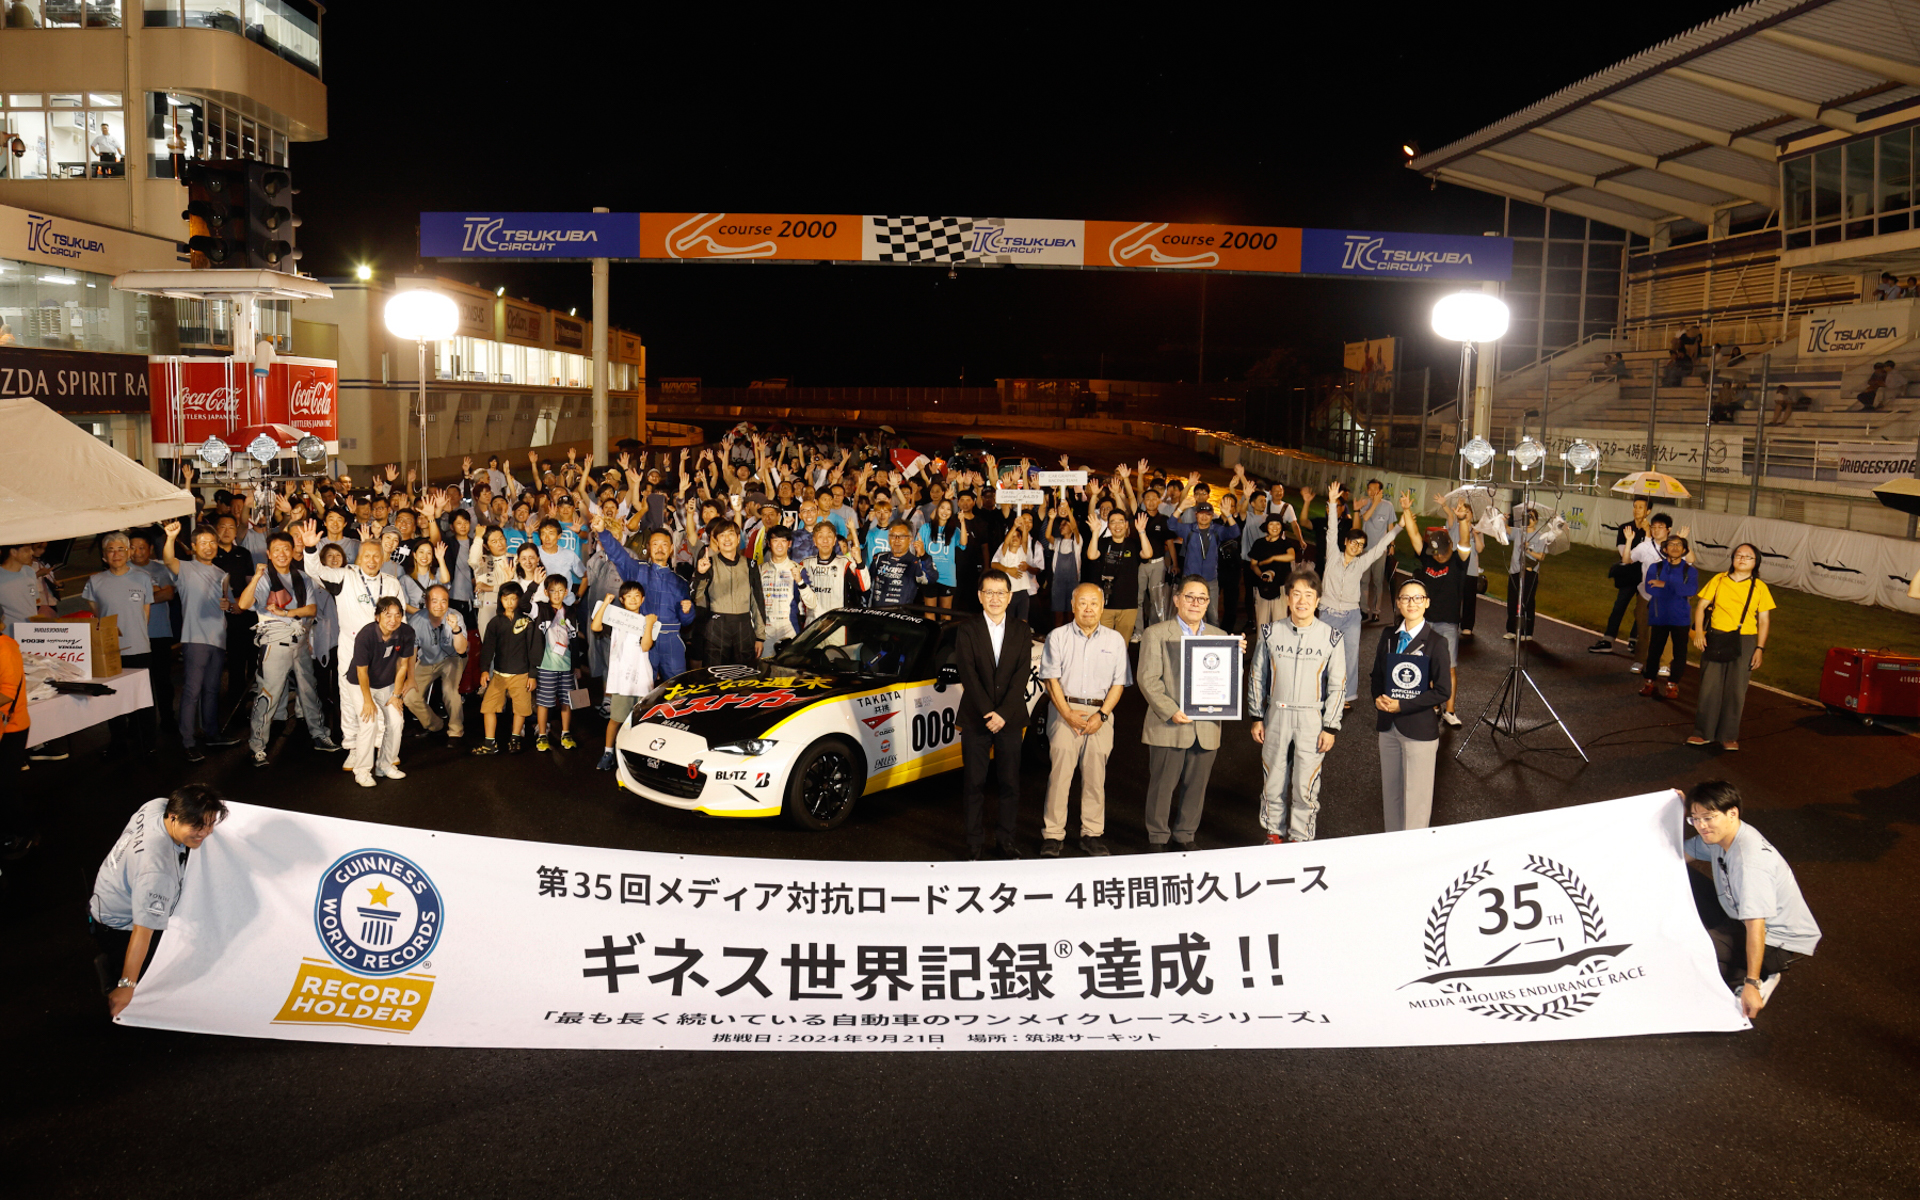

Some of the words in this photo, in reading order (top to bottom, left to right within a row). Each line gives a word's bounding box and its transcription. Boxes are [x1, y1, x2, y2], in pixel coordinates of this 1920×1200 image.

[502, 229, 598, 242] TSUKUBA
[718, 224, 773, 236] course
[777, 220, 838, 239] 2000
[52, 233, 105, 254] TSUKUBA
[1000, 237, 1077, 248] TSUKUBA
[1162, 232, 1215, 246] course
[1219, 231, 1279, 251] 2000
[1382, 249, 1473, 265] TSUKUBA
[1834, 327, 1898, 342] TSUKUBA
[57, 369, 118, 396] SPIRIT
[1839, 457, 1917, 475] BRIDGESTONE
[889, 612, 924, 624] RACING
[1275, 644, 1323, 657] MAZDA
[663, 676, 834, 701] おとなの週末
[638, 689, 825, 722] ベストカー
[856, 690, 902, 708] TAKATA
[660, 719, 691, 732] MAZDA
[912, 706, 956, 752] 008
[715, 770, 748, 780] BLITZ
[333, 855, 428, 896] GUINNESS
[1478, 882, 1543, 936] 35
[1546, 914, 1564, 926] TH
[322, 897, 358, 961] WORLD
[362, 909, 437, 969] RECORDS
[300, 975, 422, 1007] RECORD
[1408, 996, 1456, 1010] MEDIA
[1458, 986, 1516, 1005] 4HOURS
[1518, 975, 1606, 998] ENDURANCE
[1607, 965, 1647, 985] RACE
[290, 995, 414, 1023] HOLDER
[541, 1010, 1331, 1027] 「最も長く続いている自動車のワンメイクレースシリーズ」
